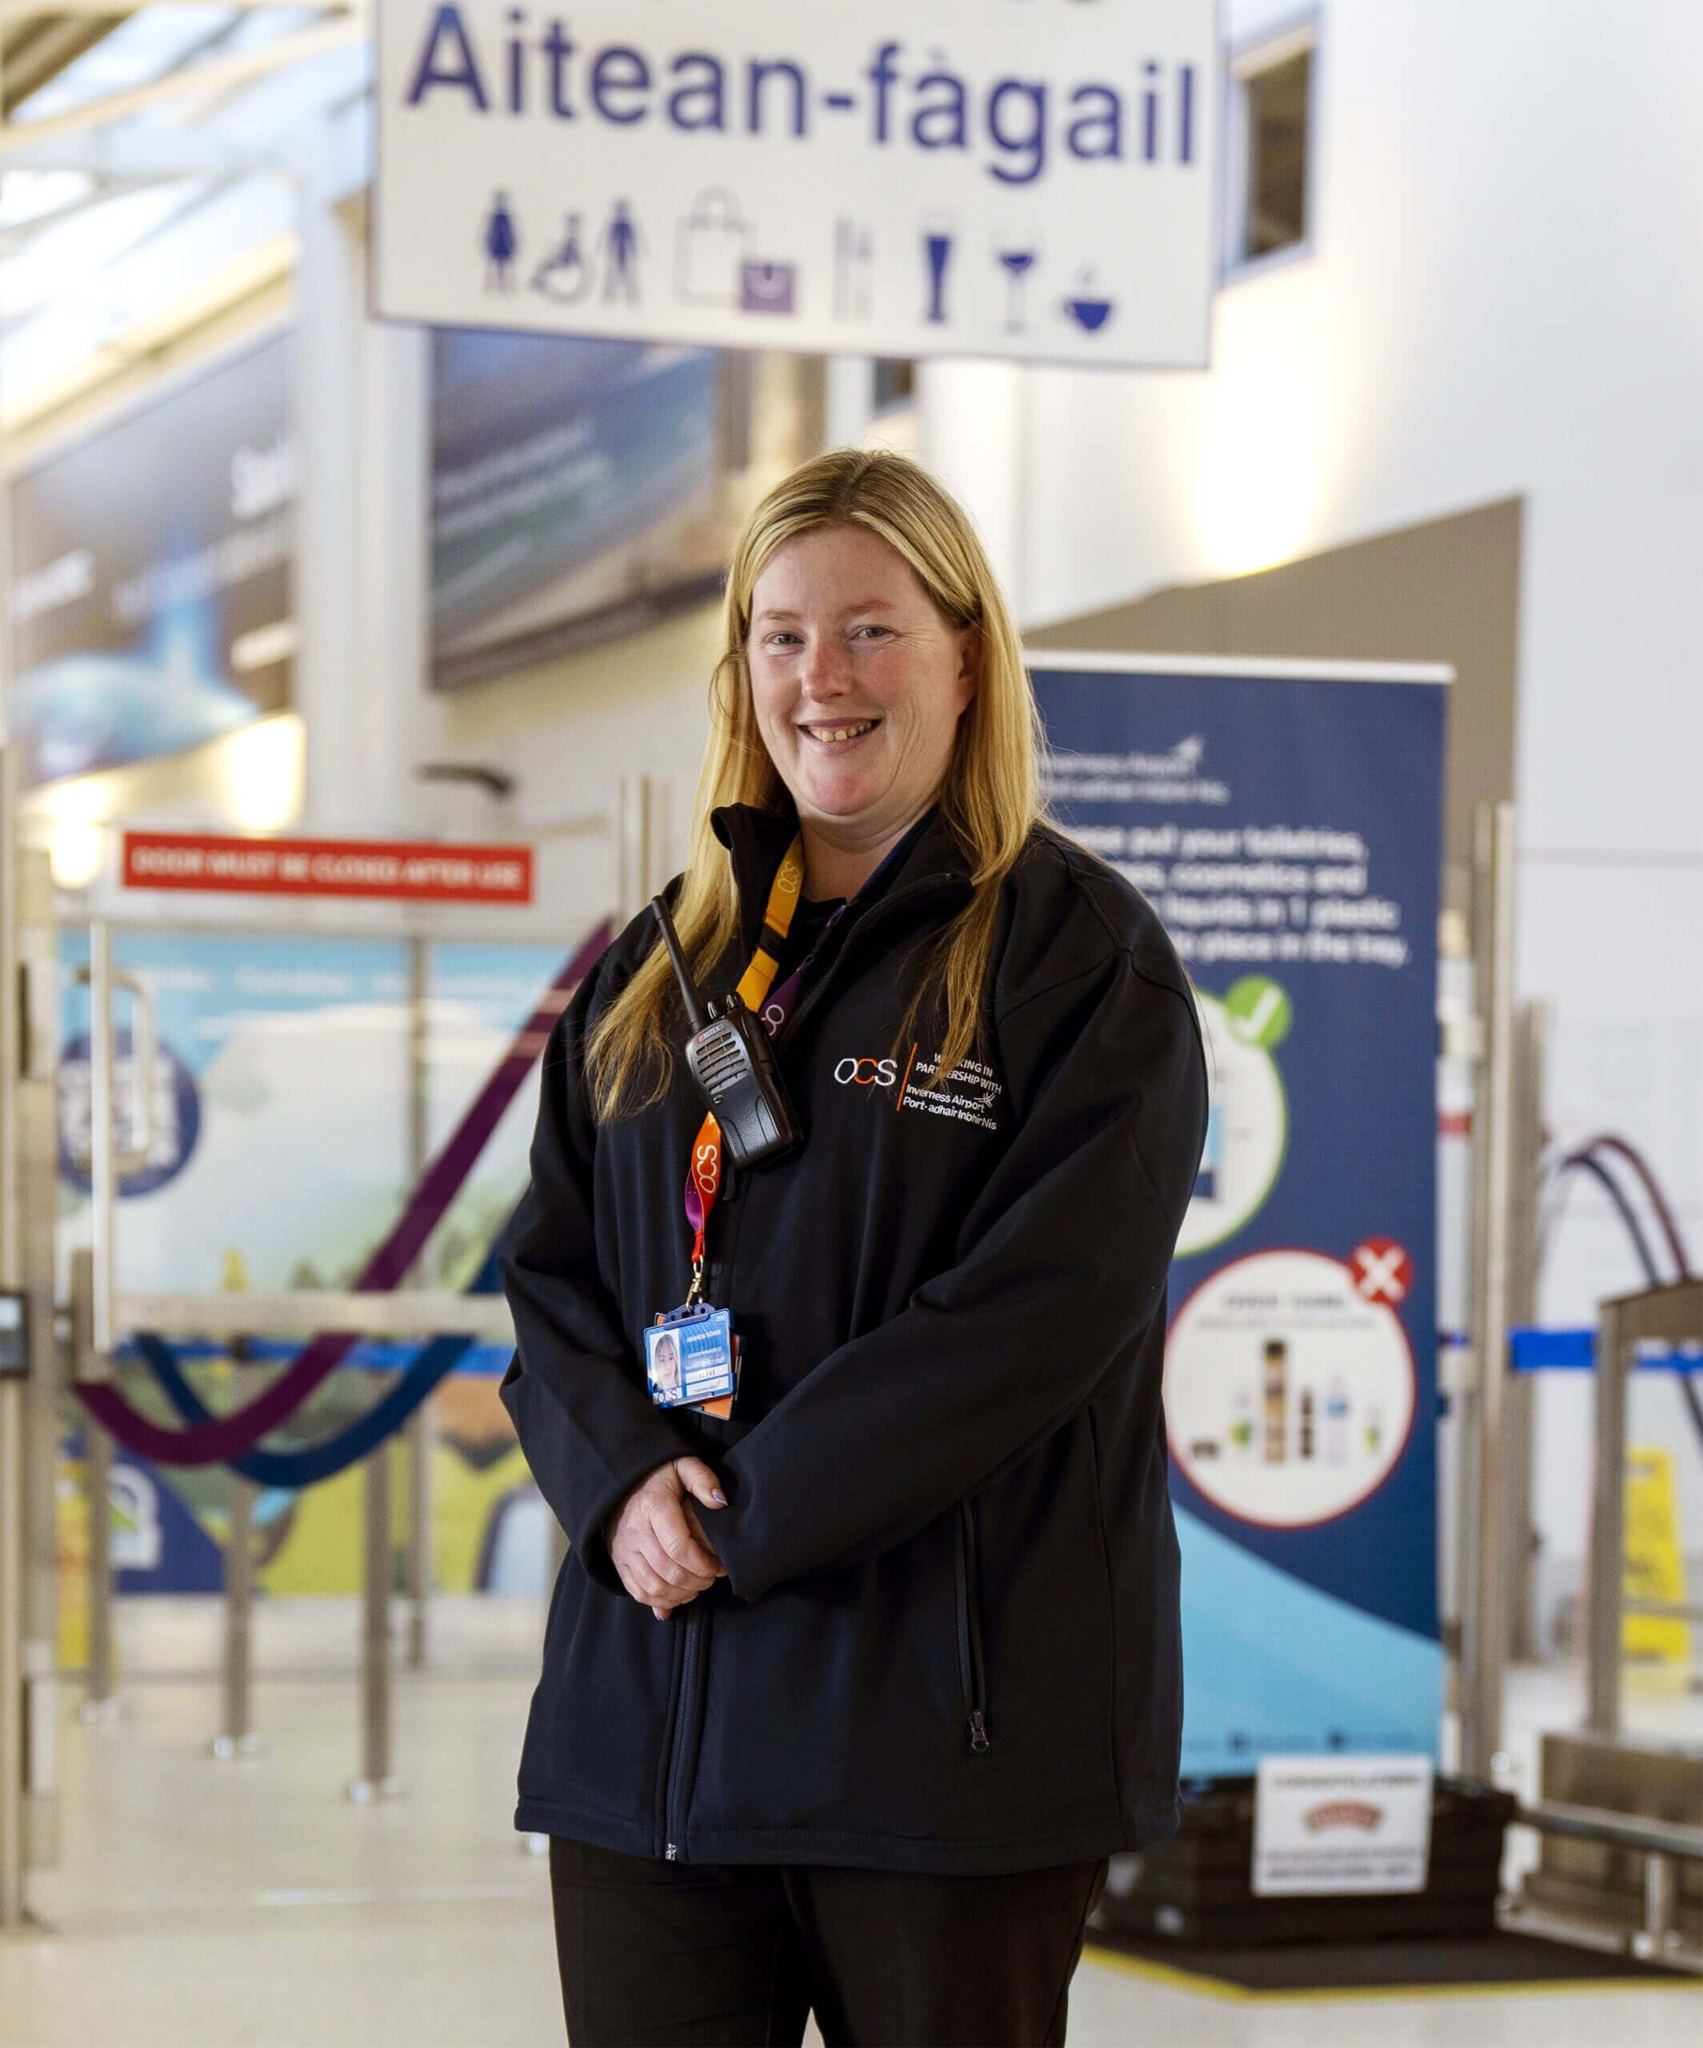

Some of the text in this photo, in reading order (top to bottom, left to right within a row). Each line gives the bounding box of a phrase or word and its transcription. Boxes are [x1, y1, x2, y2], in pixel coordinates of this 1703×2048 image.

[406, 3, 1196, 186] Aitean-fàgail
[833, 1057, 898, 1087] OCS
[980, 1077, 1002, 1095] WITH
[982, 1065, 993, 1078] IN
[905, 1083, 986, 1114] Inverness Airport
[696, 1144, 718, 1194] OCS
